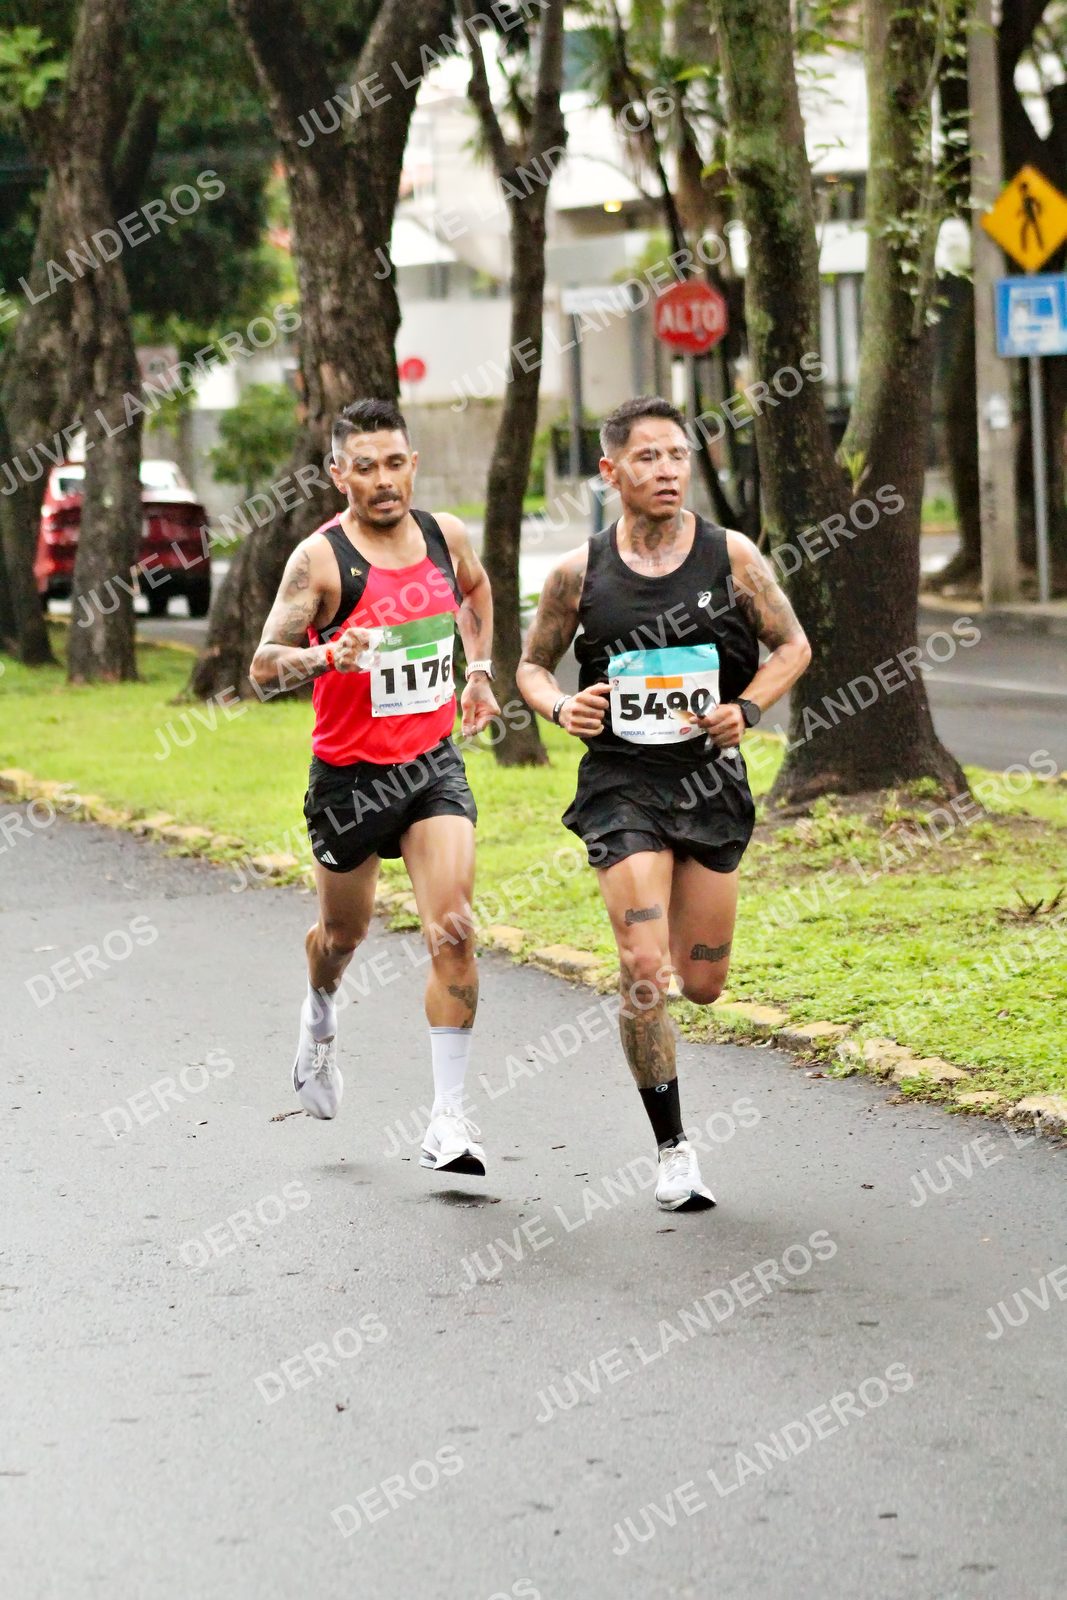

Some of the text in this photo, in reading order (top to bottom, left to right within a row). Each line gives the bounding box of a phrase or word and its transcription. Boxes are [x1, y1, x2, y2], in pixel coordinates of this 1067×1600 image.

[659, 301, 719, 334] ALTO
[380, 655, 451, 694] 1176
[619, 688, 711, 721] 5490
